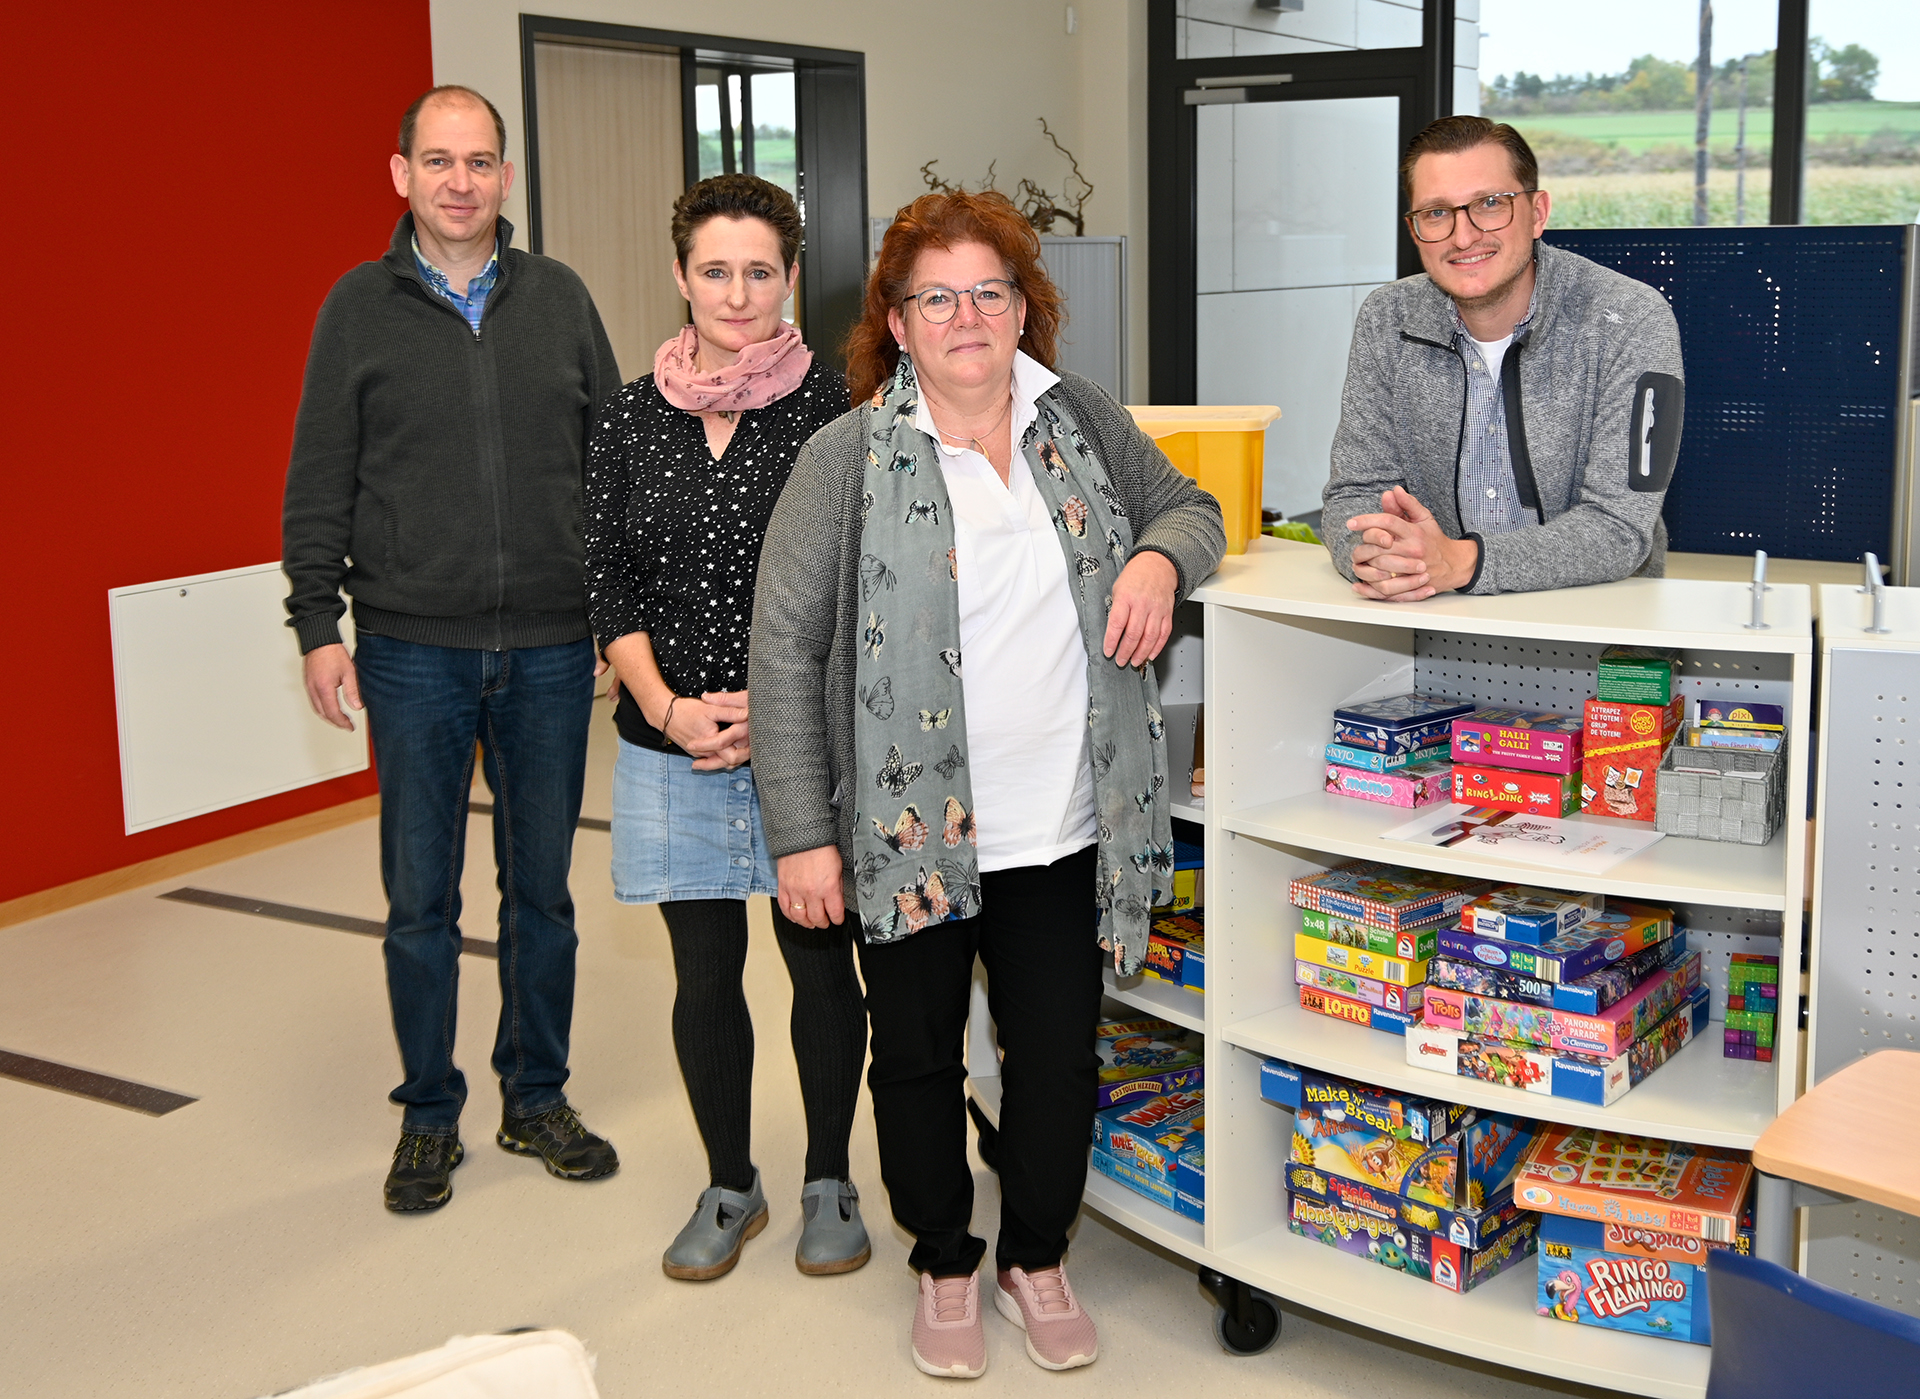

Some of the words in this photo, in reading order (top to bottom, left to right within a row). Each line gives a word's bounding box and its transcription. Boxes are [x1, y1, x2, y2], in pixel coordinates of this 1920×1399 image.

[1591, 706, 1621, 715] ATTRAPEZ
[1732, 712, 1750, 720] pixi
[1600, 714, 1619, 722] TOTEM
[1499, 730, 1530, 741] HALLI
[1600, 730, 1622, 738] TOTEM!
[1498, 739, 1530, 750] GALLI
[1326, 747, 1354, 760] SKYJO
[1414, 746, 1439, 760] SKYJO
[1346, 778, 1392, 797] memo
[1304, 917, 1325, 930] 3x48
[1508, 917, 1537, 928] Ravensburger
[1369, 927, 1394, 938] Schmidt
[1369, 934, 1389, 944] Puzzle
[1480, 944, 1498, 955] Schauen
[1477, 951, 1504, 962] Vergleichen
[1302, 969, 1312, 979] 60
[1354, 964, 1374, 976] Puzzle
[1519, 980, 1540, 996] 500
[1556, 984, 1594, 996] Ravensburger
[1324, 997, 1368, 1022] LOTTO
[1373, 1007, 1411, 1024] Ravensburger
[1564, 1018, 1606, 1032] PANORAMA
[1570, 1028, 1599, 1040] PARADE
[1570, 1040, 1606, 1051] Clementoni
[1261, 1065, 1298, 1082] Ravensburger
[1524, 1068, 1534, 1076] 60
[1555, 1060, 1602, 1076] Ravensburger
[1112, 1089, 1122, 1098] 1-2-3
[1122, 1083, 1136, 1093] TOLLE
[1138, 1082, 1161, 1092] HEXEREI
[1306, 1086, 1350, 1102] Make
[1344, 1101, 1397, 1136] Break
[1110, 1134, 1134, 1151] MAKE
[1474, 1122, 1500, 1168] SOS
[1136, 1146, 1166, 1173] BREAK
[1328, 1176, 1372, 1200] Spiele
[1341, 1190, 1397, 1218] Sammlung
[1558, 1196, 1600, 1218] Hurra,
[1603, 1203, 1622, 1222] ich
[1626, 1209, 1667, 1233] hab's!
[1672, 1222, 1682, 1230] 5+
[1589, 1260, 1668, 1290] RINGO
[1436, 1276, 1456, 1288] Schmidt
[1586, 1280, 1684, 1317] FLAMINGO
